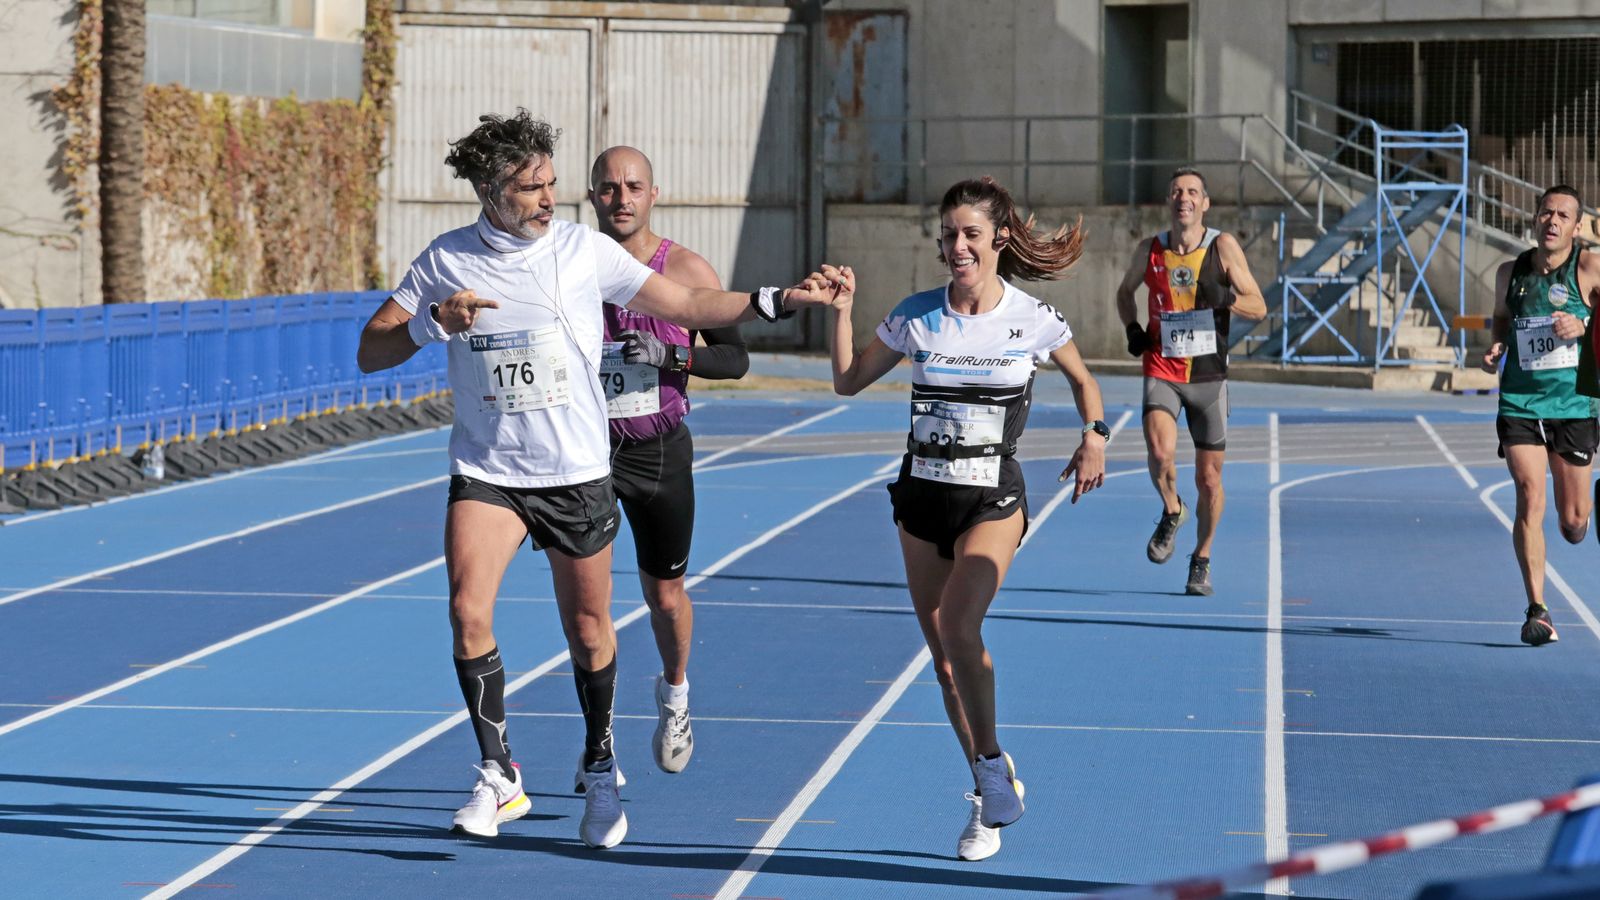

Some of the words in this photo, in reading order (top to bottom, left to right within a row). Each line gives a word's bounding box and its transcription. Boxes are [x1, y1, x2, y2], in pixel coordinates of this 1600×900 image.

[1171, 329, 1194, 343] 674
[472, 337, 488, 348] XXV
[1528, 337, 1554, 353] 130
[501, 348, 536, 358] ANDRES
[931, 353, 1017, 366] TrailRunner
[493, 361, 535, 388] 176
[914, 403, 932, 413] XXV
[936, 420, 975, 430] JENNIFER
